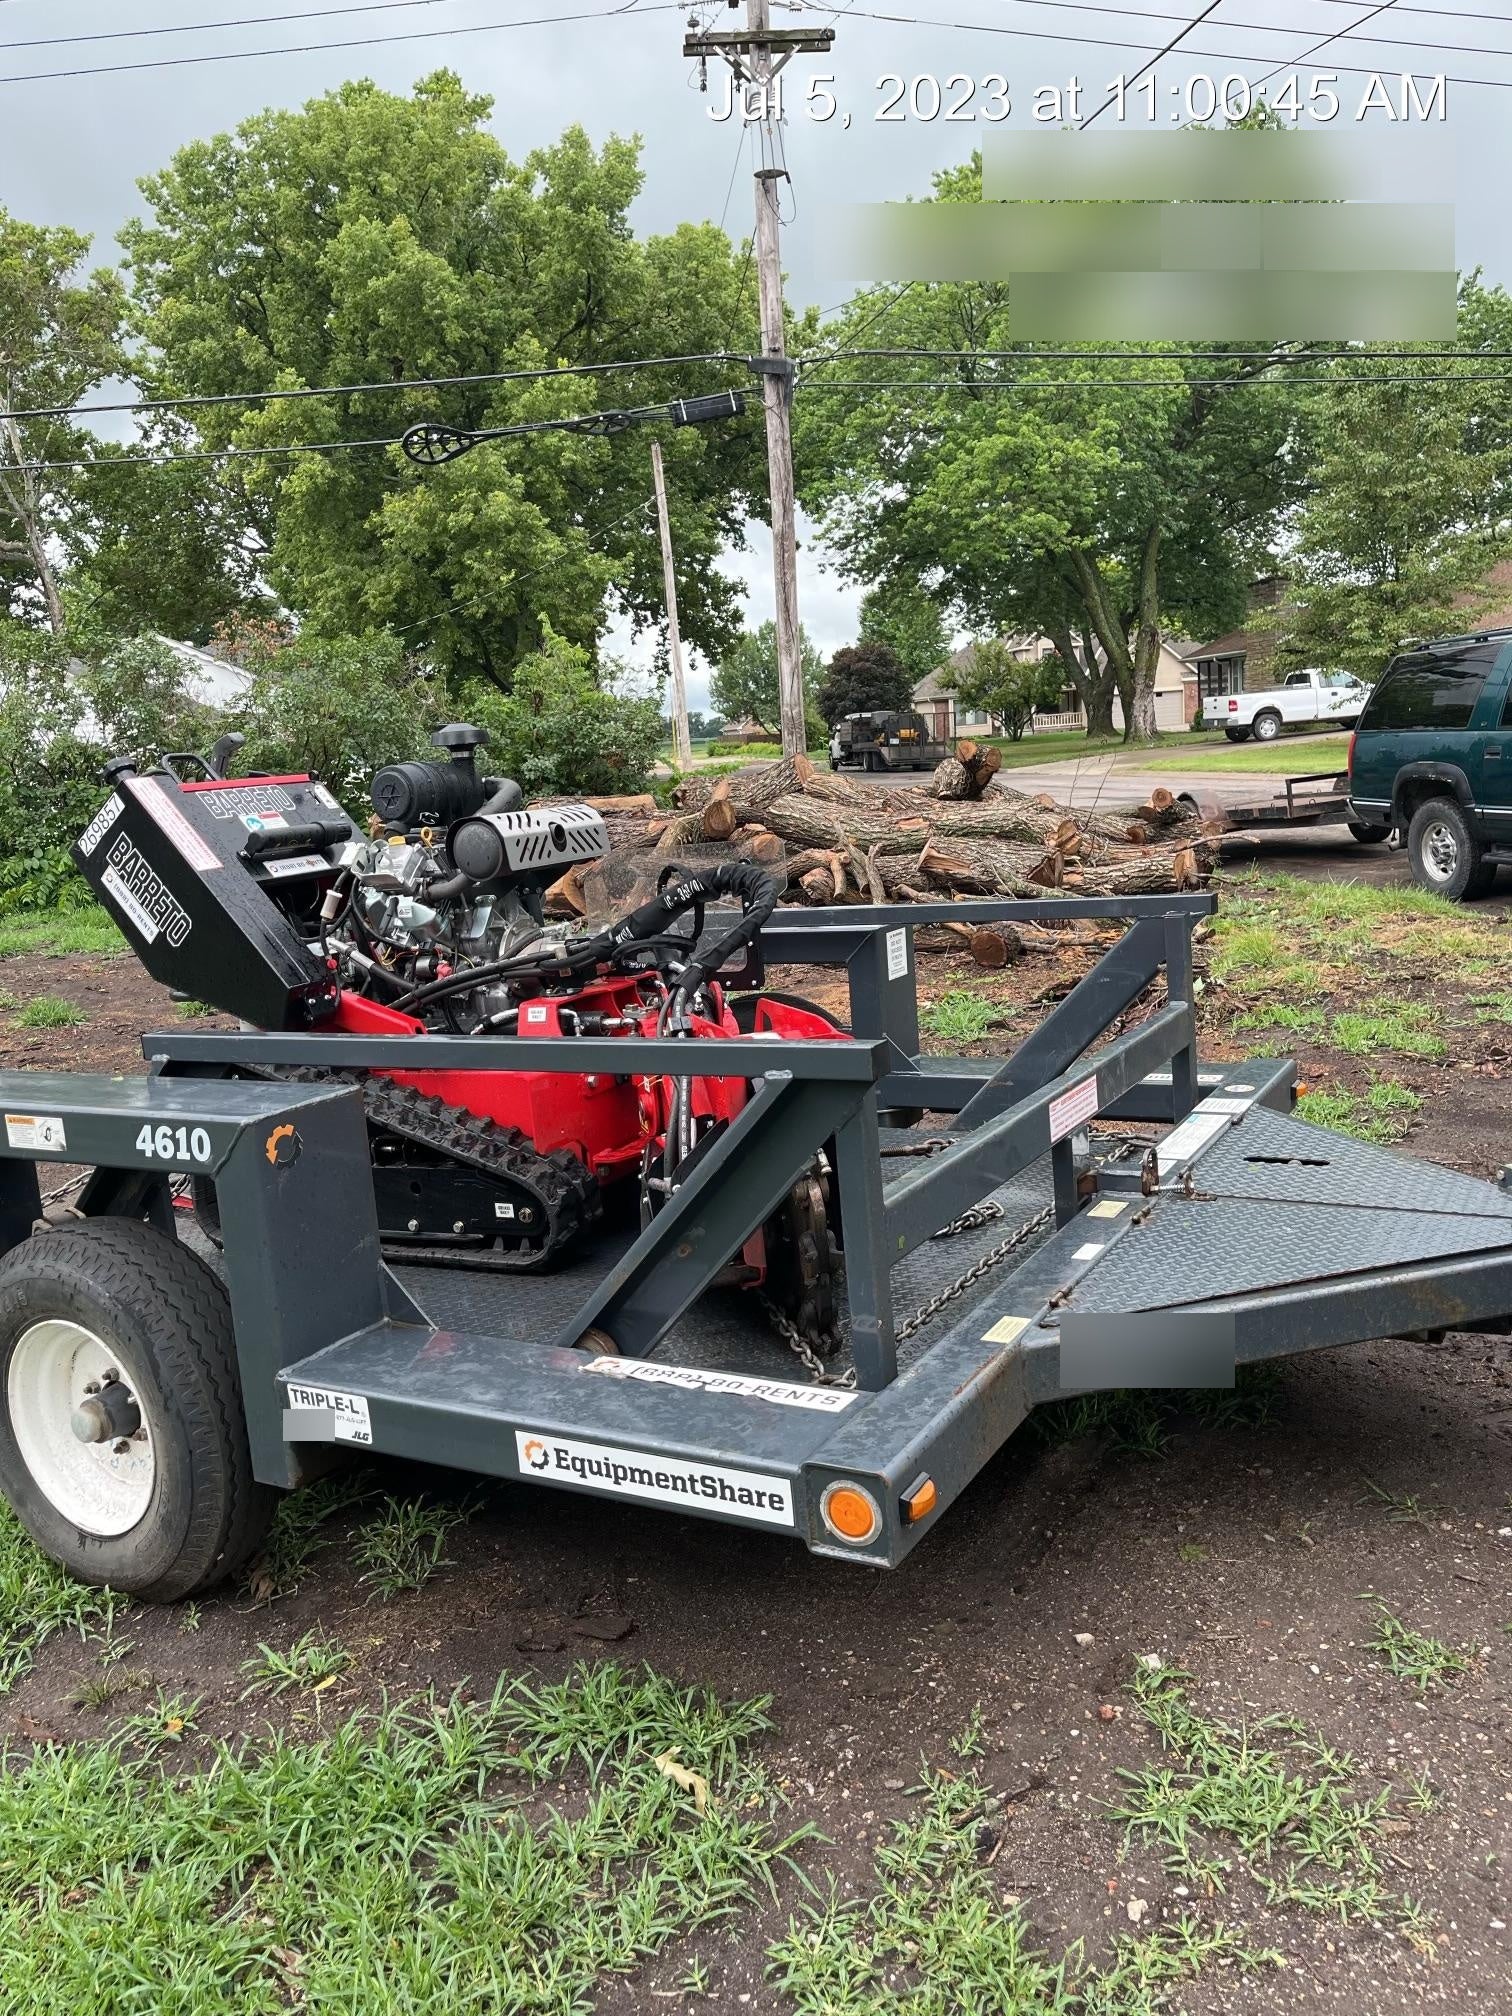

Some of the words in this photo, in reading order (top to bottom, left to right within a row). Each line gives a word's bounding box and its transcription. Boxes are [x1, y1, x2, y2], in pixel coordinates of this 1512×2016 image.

[194, 784, 297, 819] BARRETO
[79, 794, 122, 854] 269857
[106, 830, 192, 947] BARRETO
[135, 1124, 212, 1163] 4610
[290, 1387, 360, 1414] TRIPLE-L
[351, 1430, 370, 1441] JLG
[553, 1446, 786, 1513] EquipmentShare
